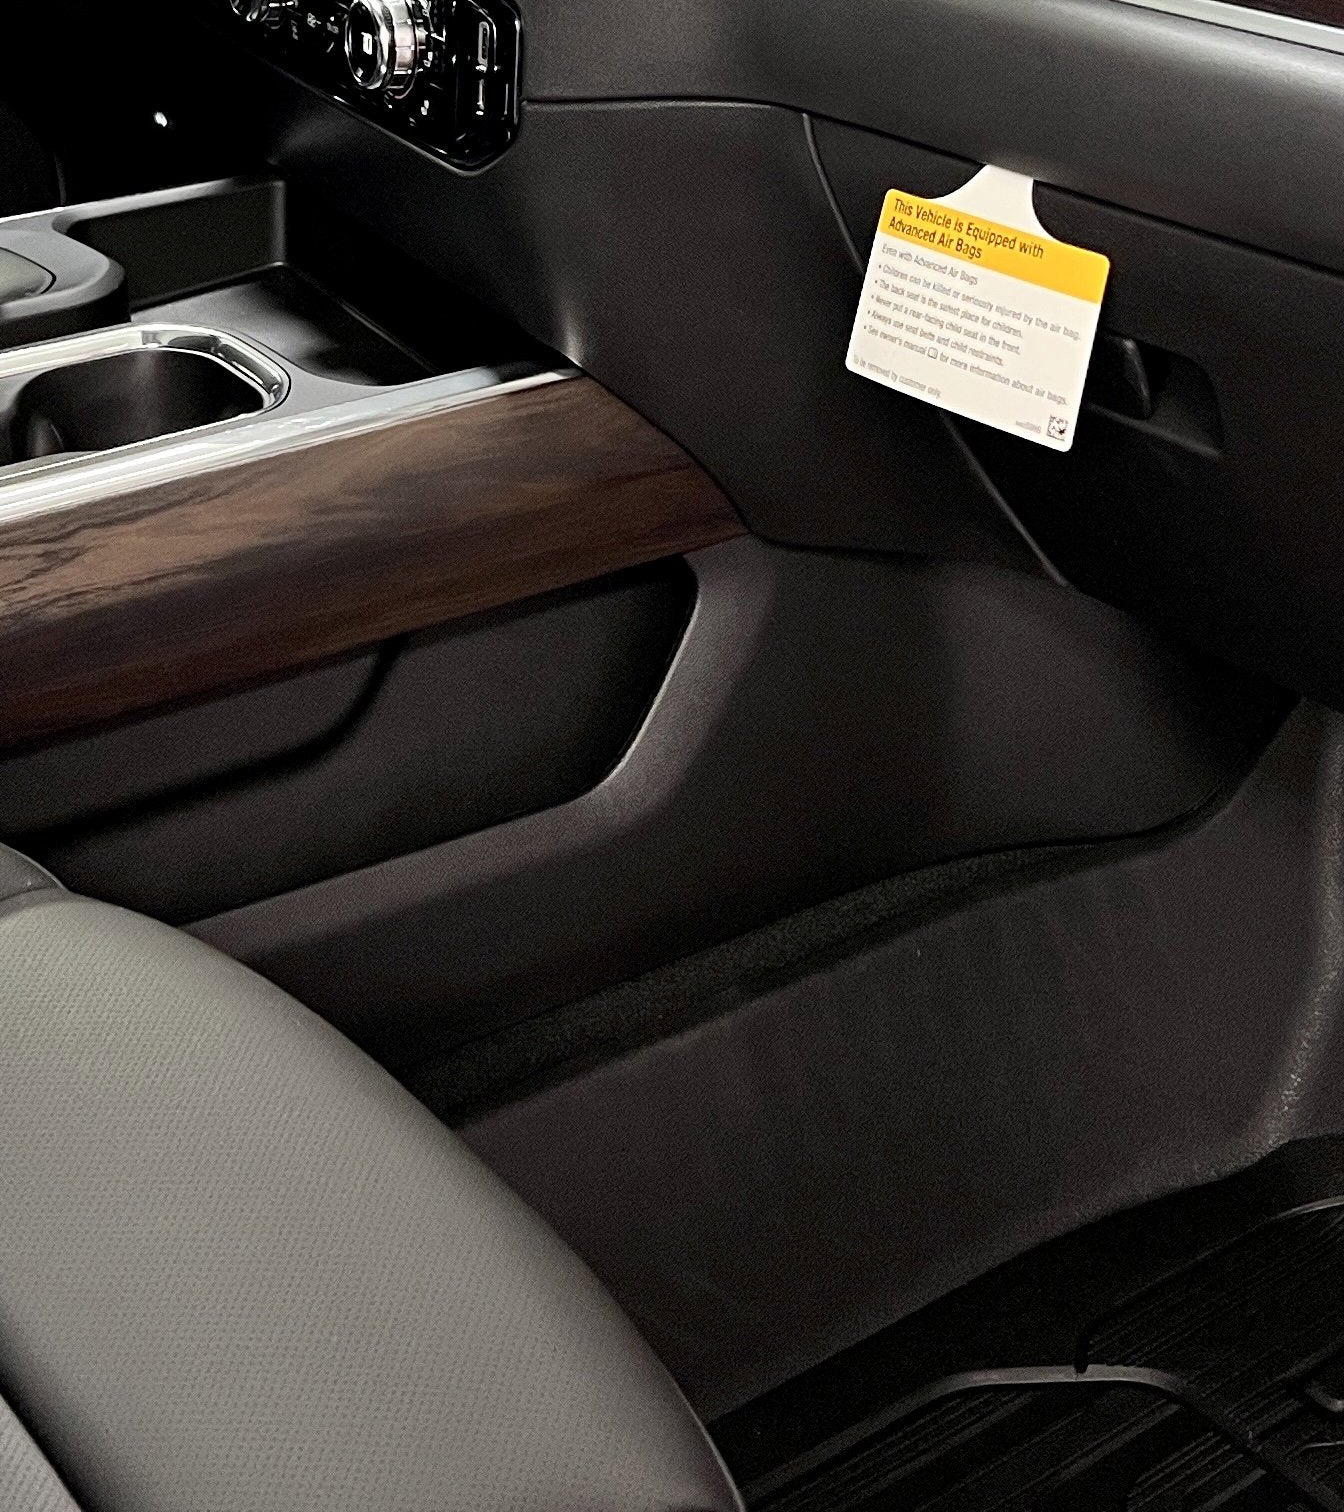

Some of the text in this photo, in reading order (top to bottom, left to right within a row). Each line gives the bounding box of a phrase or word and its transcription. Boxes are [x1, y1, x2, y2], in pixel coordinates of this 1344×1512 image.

[888, 216, 982, 259] Advanced Air Bags
[894, 198, 913, 216] This
[916, 205, 952, 229] Vehicle
[966, 222, 1017, 250] Equipped
[1019, 242, 1044, 258] with
